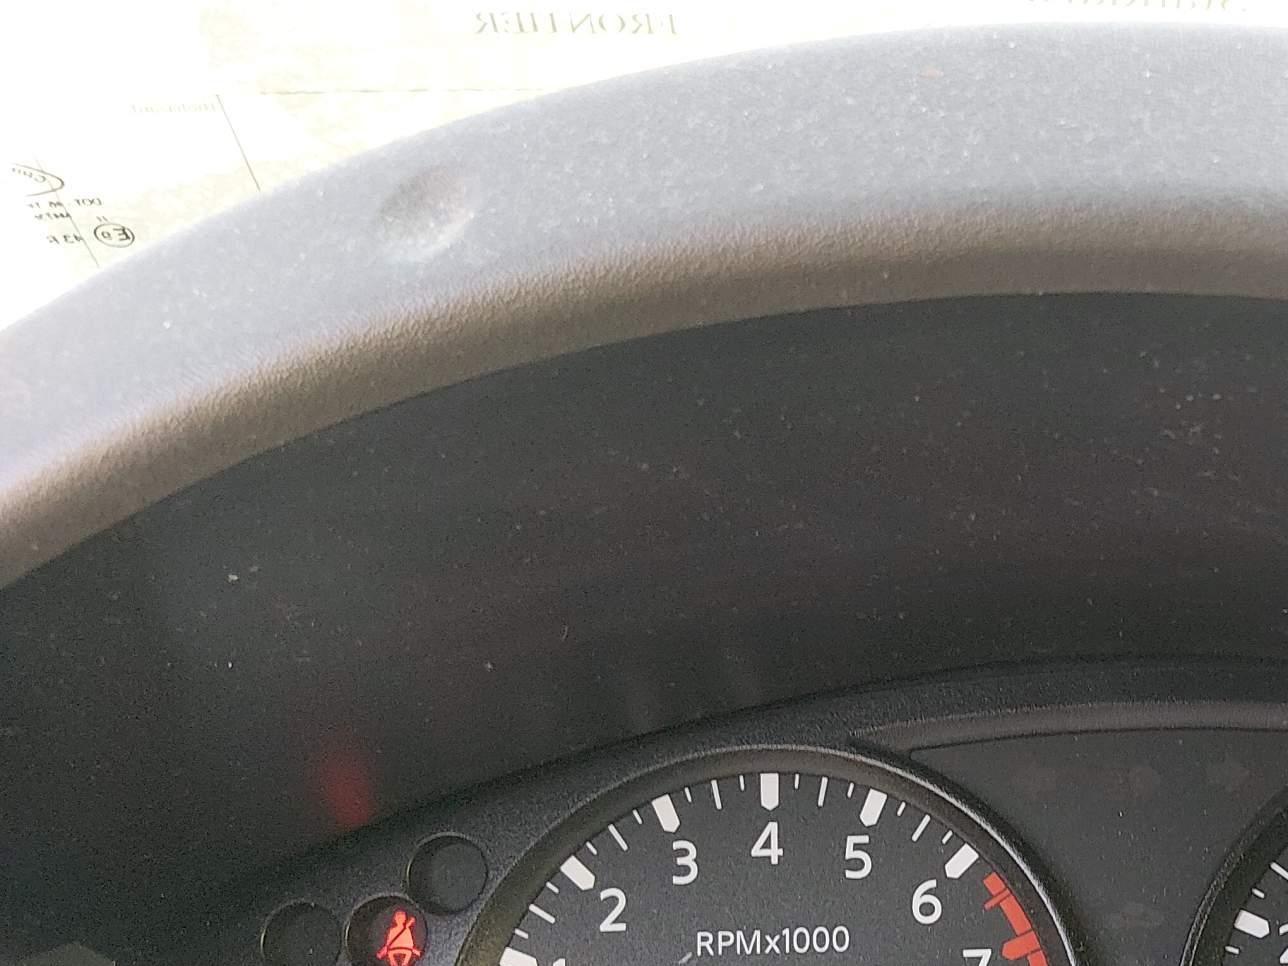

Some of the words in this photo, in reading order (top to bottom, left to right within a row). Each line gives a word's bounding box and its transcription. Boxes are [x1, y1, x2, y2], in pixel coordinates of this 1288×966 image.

[672, 840, 699, 885] 3
[751, 821, 784, 865] 4
[844, 835, 873, 879] 5
[599, 888, 628, 932] 2
[912, 879, 943, 925] 6
[696, 926, 851, 957] RPMx1000
